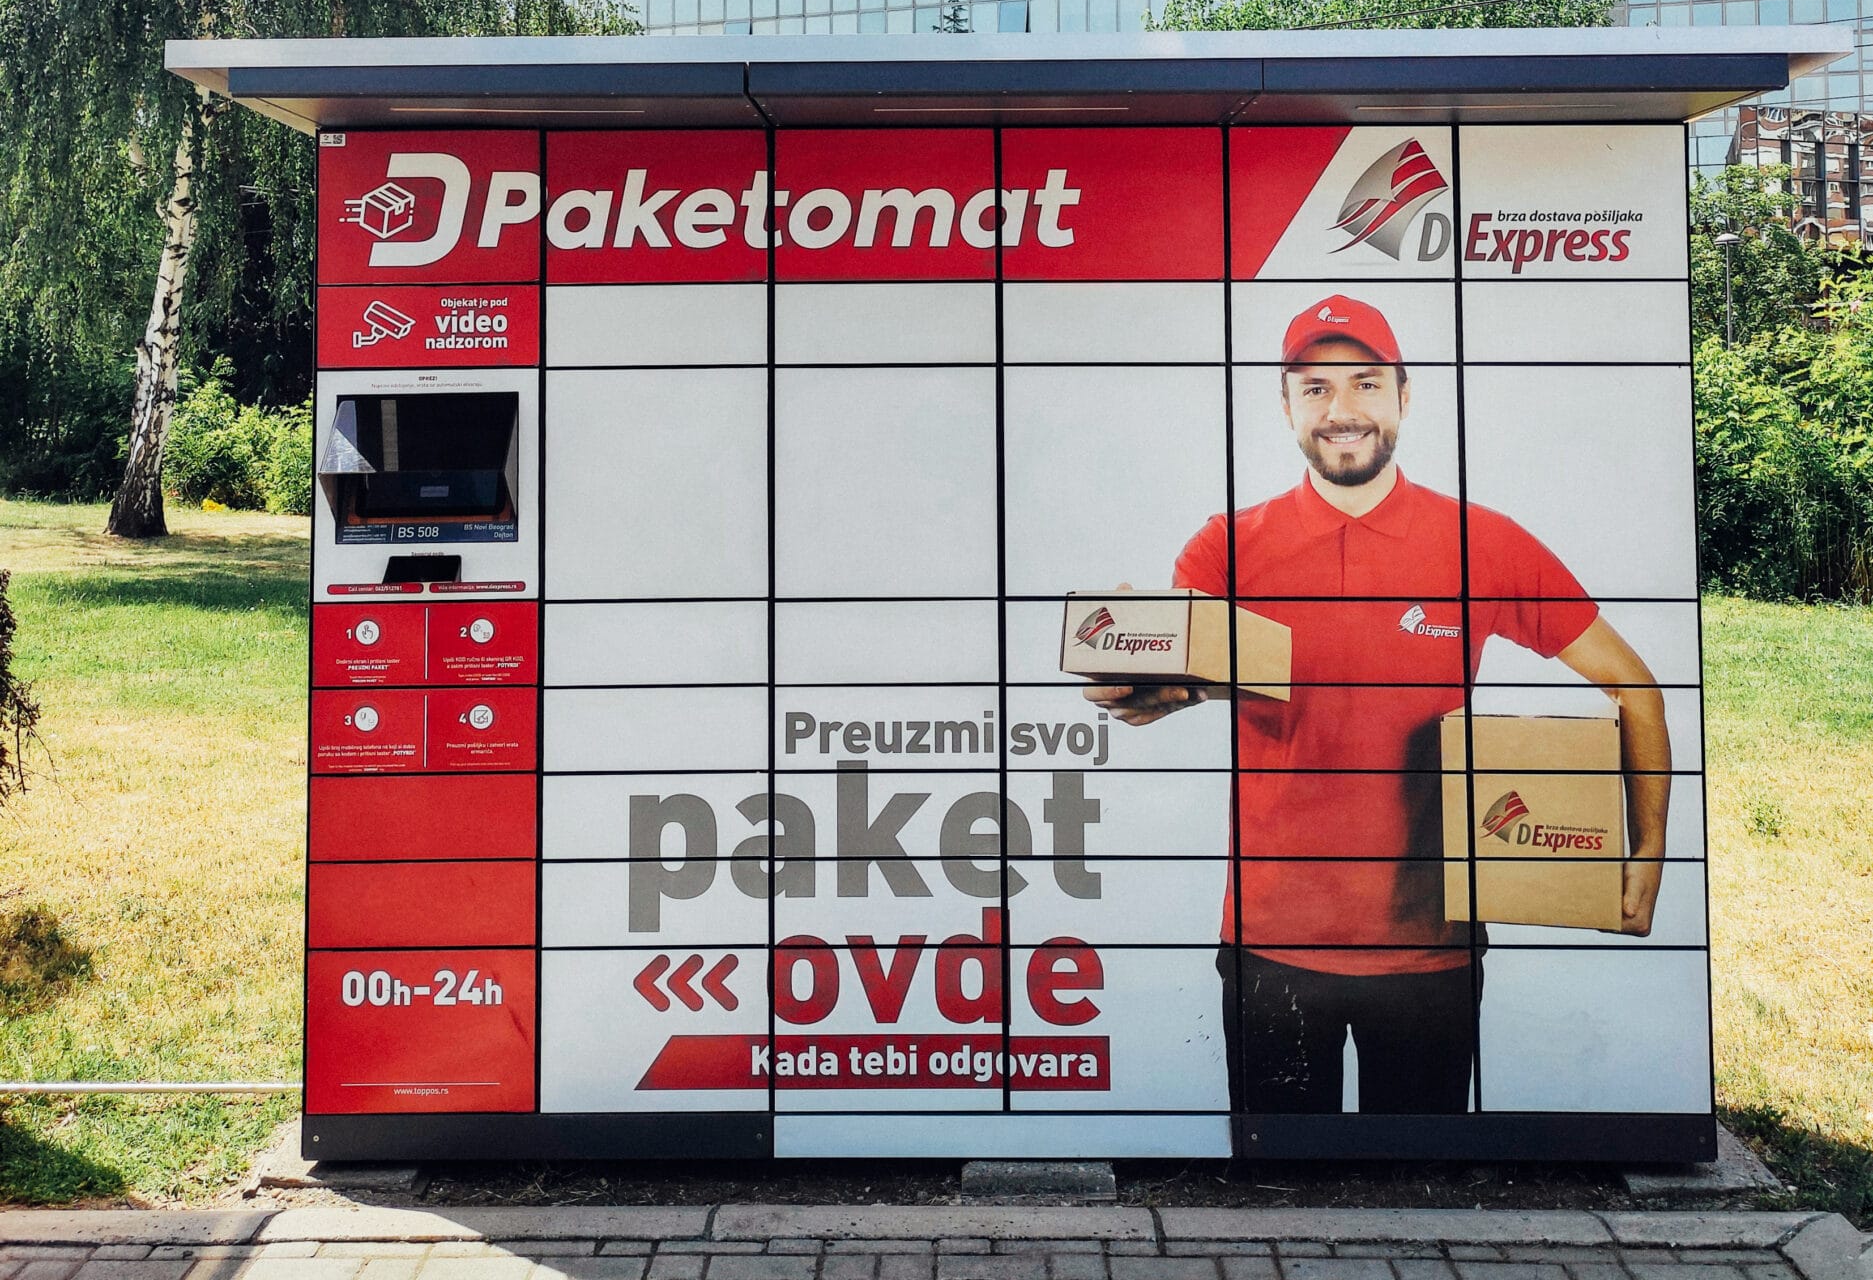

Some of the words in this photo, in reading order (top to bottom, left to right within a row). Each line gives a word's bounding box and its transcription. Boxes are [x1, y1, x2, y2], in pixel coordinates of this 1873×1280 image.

[477, 168, 1082, 250] Paketomat
[1497, 210, 1526, 222] brza
[1529, 210, 1582, 223] dostava
[1584, 210, 1643, 225] pošiljaka
[440, 297, 476, 310] Objekat
[478, 298, 488, 310] je
[490, 297, 508, 308] pod
[434, 310, 508, 334] video
[425, 334, 508, 350] nadzorom
[398, 527, 415, 538] BS
[417, 526, 440, 538] 508
[346, 628, 352, 639] 1
[460, 626, 468, 638] 2
[344, 715, 352, 726] 3
[459, 713, 467, 724] 4
[784, 710, 996, 755] Preuzmi
[1009, 712, 1110, 766] svoj
[628, 759, 1103, 933] paket
[767, 906, 1105, 1026] ovde
[341, 969, 503, 1008] 00h-24h
[751, 1044, 840, 1077] Kada
[849, 1044, 918, 1077] tebi
[928, 1044, 1099, 1082] odgovara
